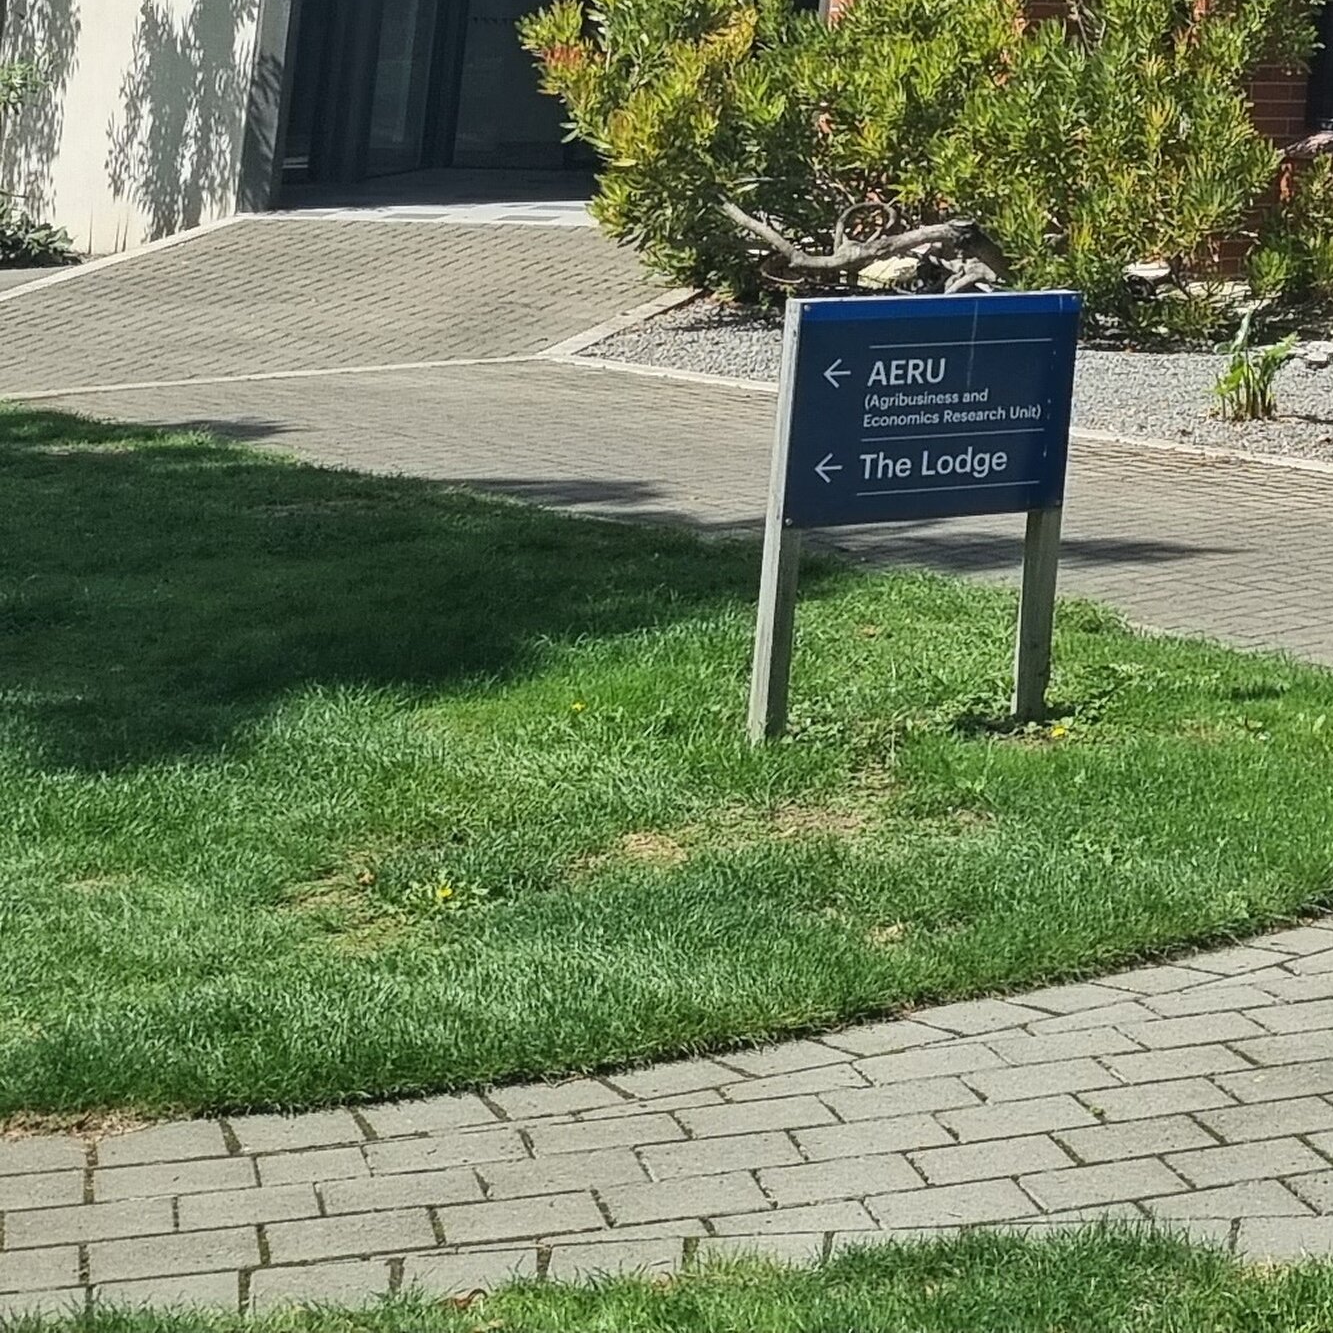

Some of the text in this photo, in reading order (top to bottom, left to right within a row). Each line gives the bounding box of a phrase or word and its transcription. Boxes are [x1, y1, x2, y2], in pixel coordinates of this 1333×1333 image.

[867, 358, 946, 386] AERU
[864, 388, 989, 410] (Agribusiness and
[863, 403, 1042, 428] Economics Research Unit)
[859, 446, 1008, 480] The Lodge
